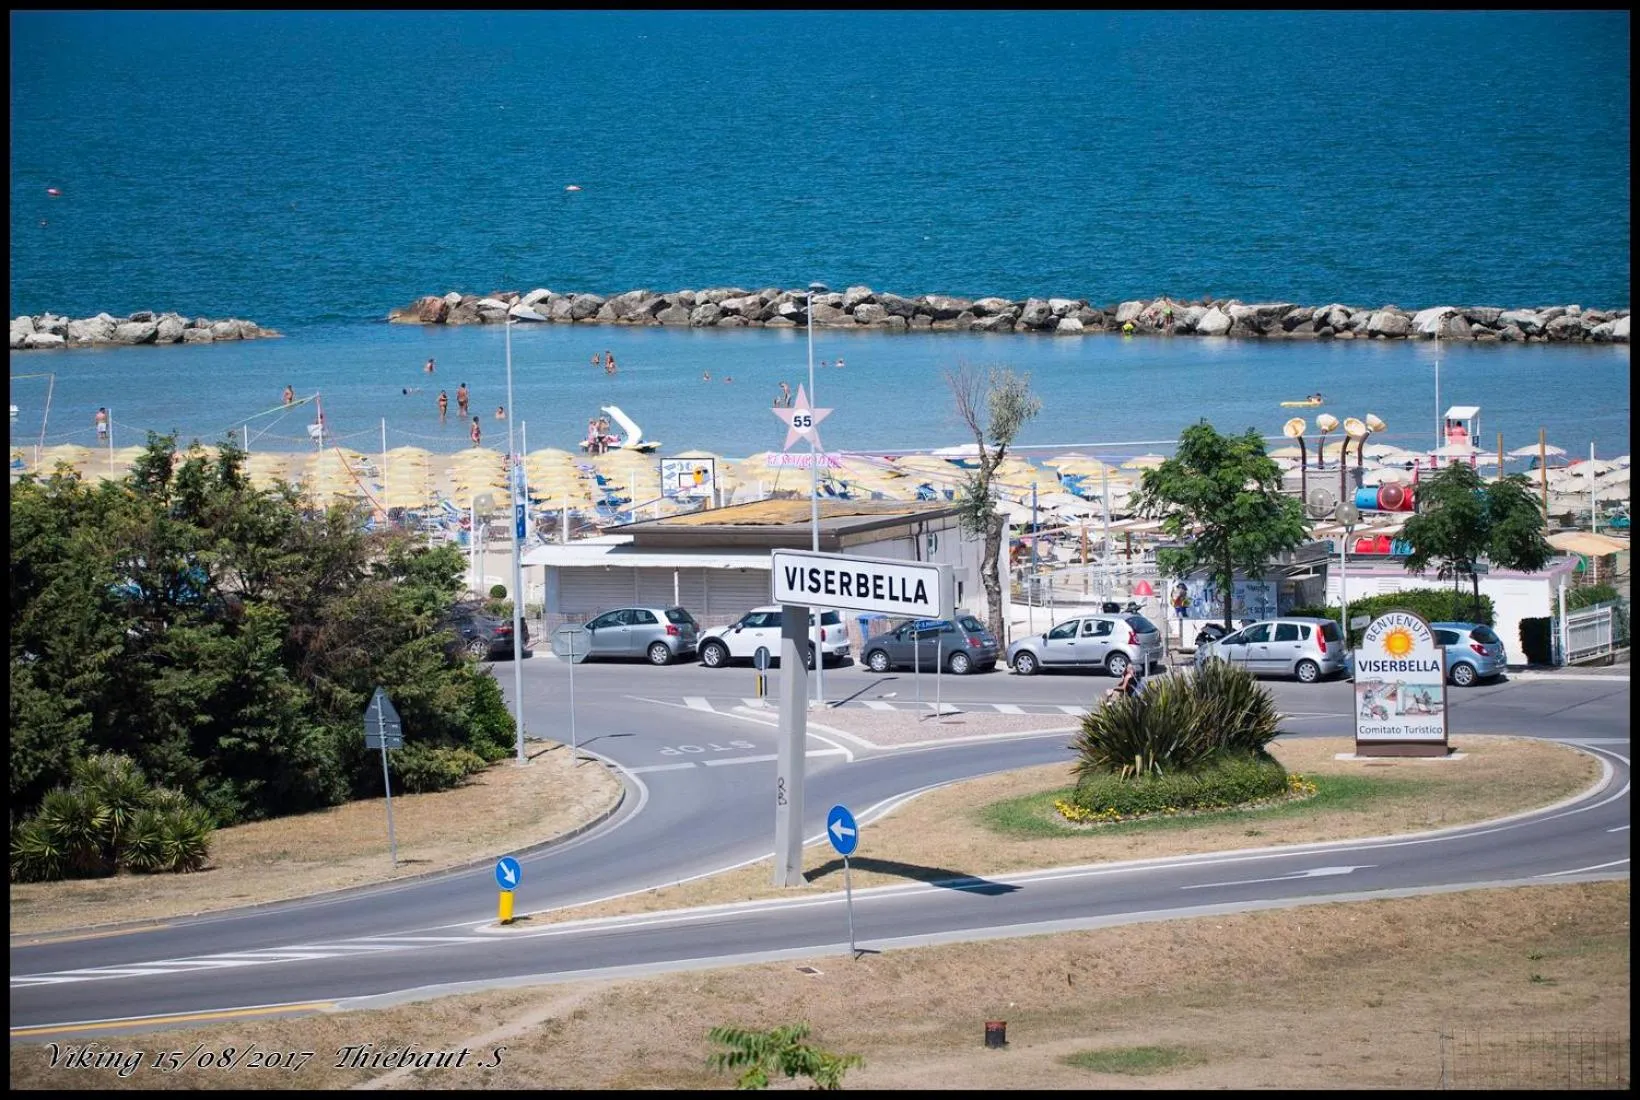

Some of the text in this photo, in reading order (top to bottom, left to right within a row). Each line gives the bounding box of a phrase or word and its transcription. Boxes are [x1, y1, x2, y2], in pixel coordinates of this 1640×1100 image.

[793, 415, 812, 428] 55
[785, 566, 929, 605] VISERBELLA
[1366, 614, 1431, 642] BENVENUTI
[1358, 660, 1441, 672] VISERBELLA
[1359, 725, 1443, 735] Comitato Turistico
[658, 740, 756, 756] STOP
